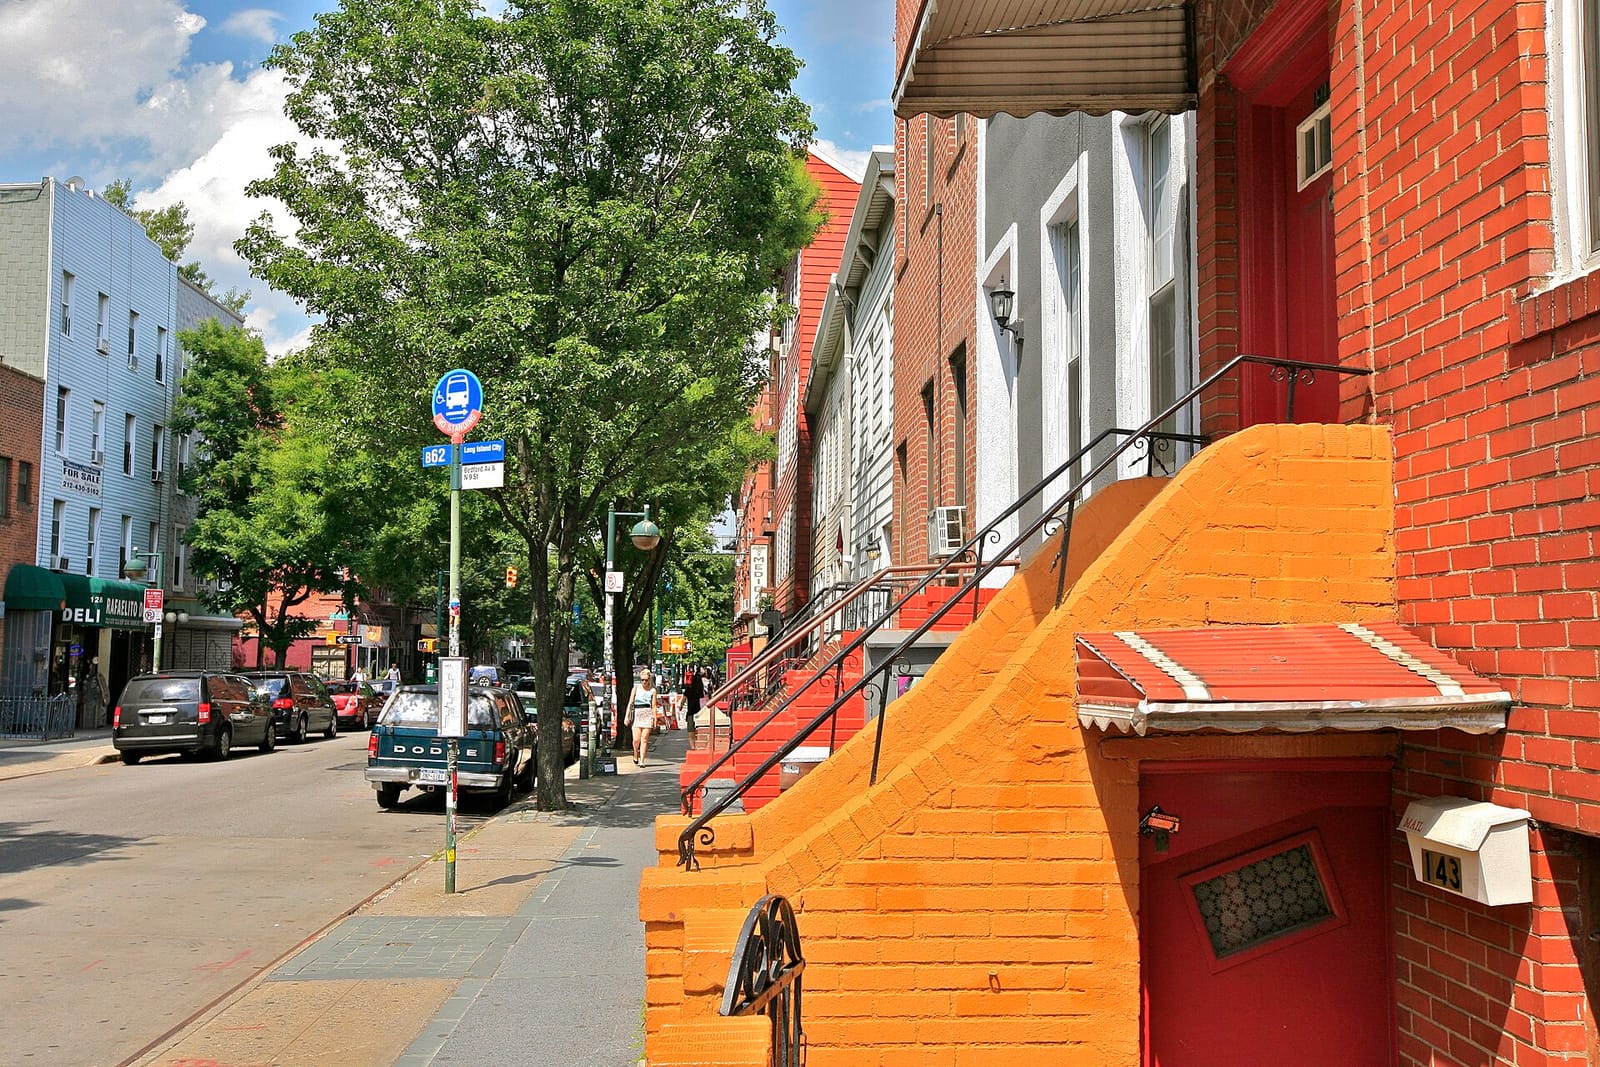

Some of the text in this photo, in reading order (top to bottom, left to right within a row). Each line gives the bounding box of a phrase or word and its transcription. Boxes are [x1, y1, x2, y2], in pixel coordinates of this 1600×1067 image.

[426, 448, 445, 464] B62
[476, 444, 491, 452] Island
[492, 444, 502, 452] City
[64, 468, 78, 478] FOR
[81, 472, 100, 484] SALE
[754, 557, 764, 607] MEDIC
[62, 608, 100, 623] DELI
[106, 598, 138, 617] RAFAELITO
[394, 745, 478, 756] DODE
[1403, 818, 1424, 832] MAIL
[1426, 852, 1460, 888] 143
